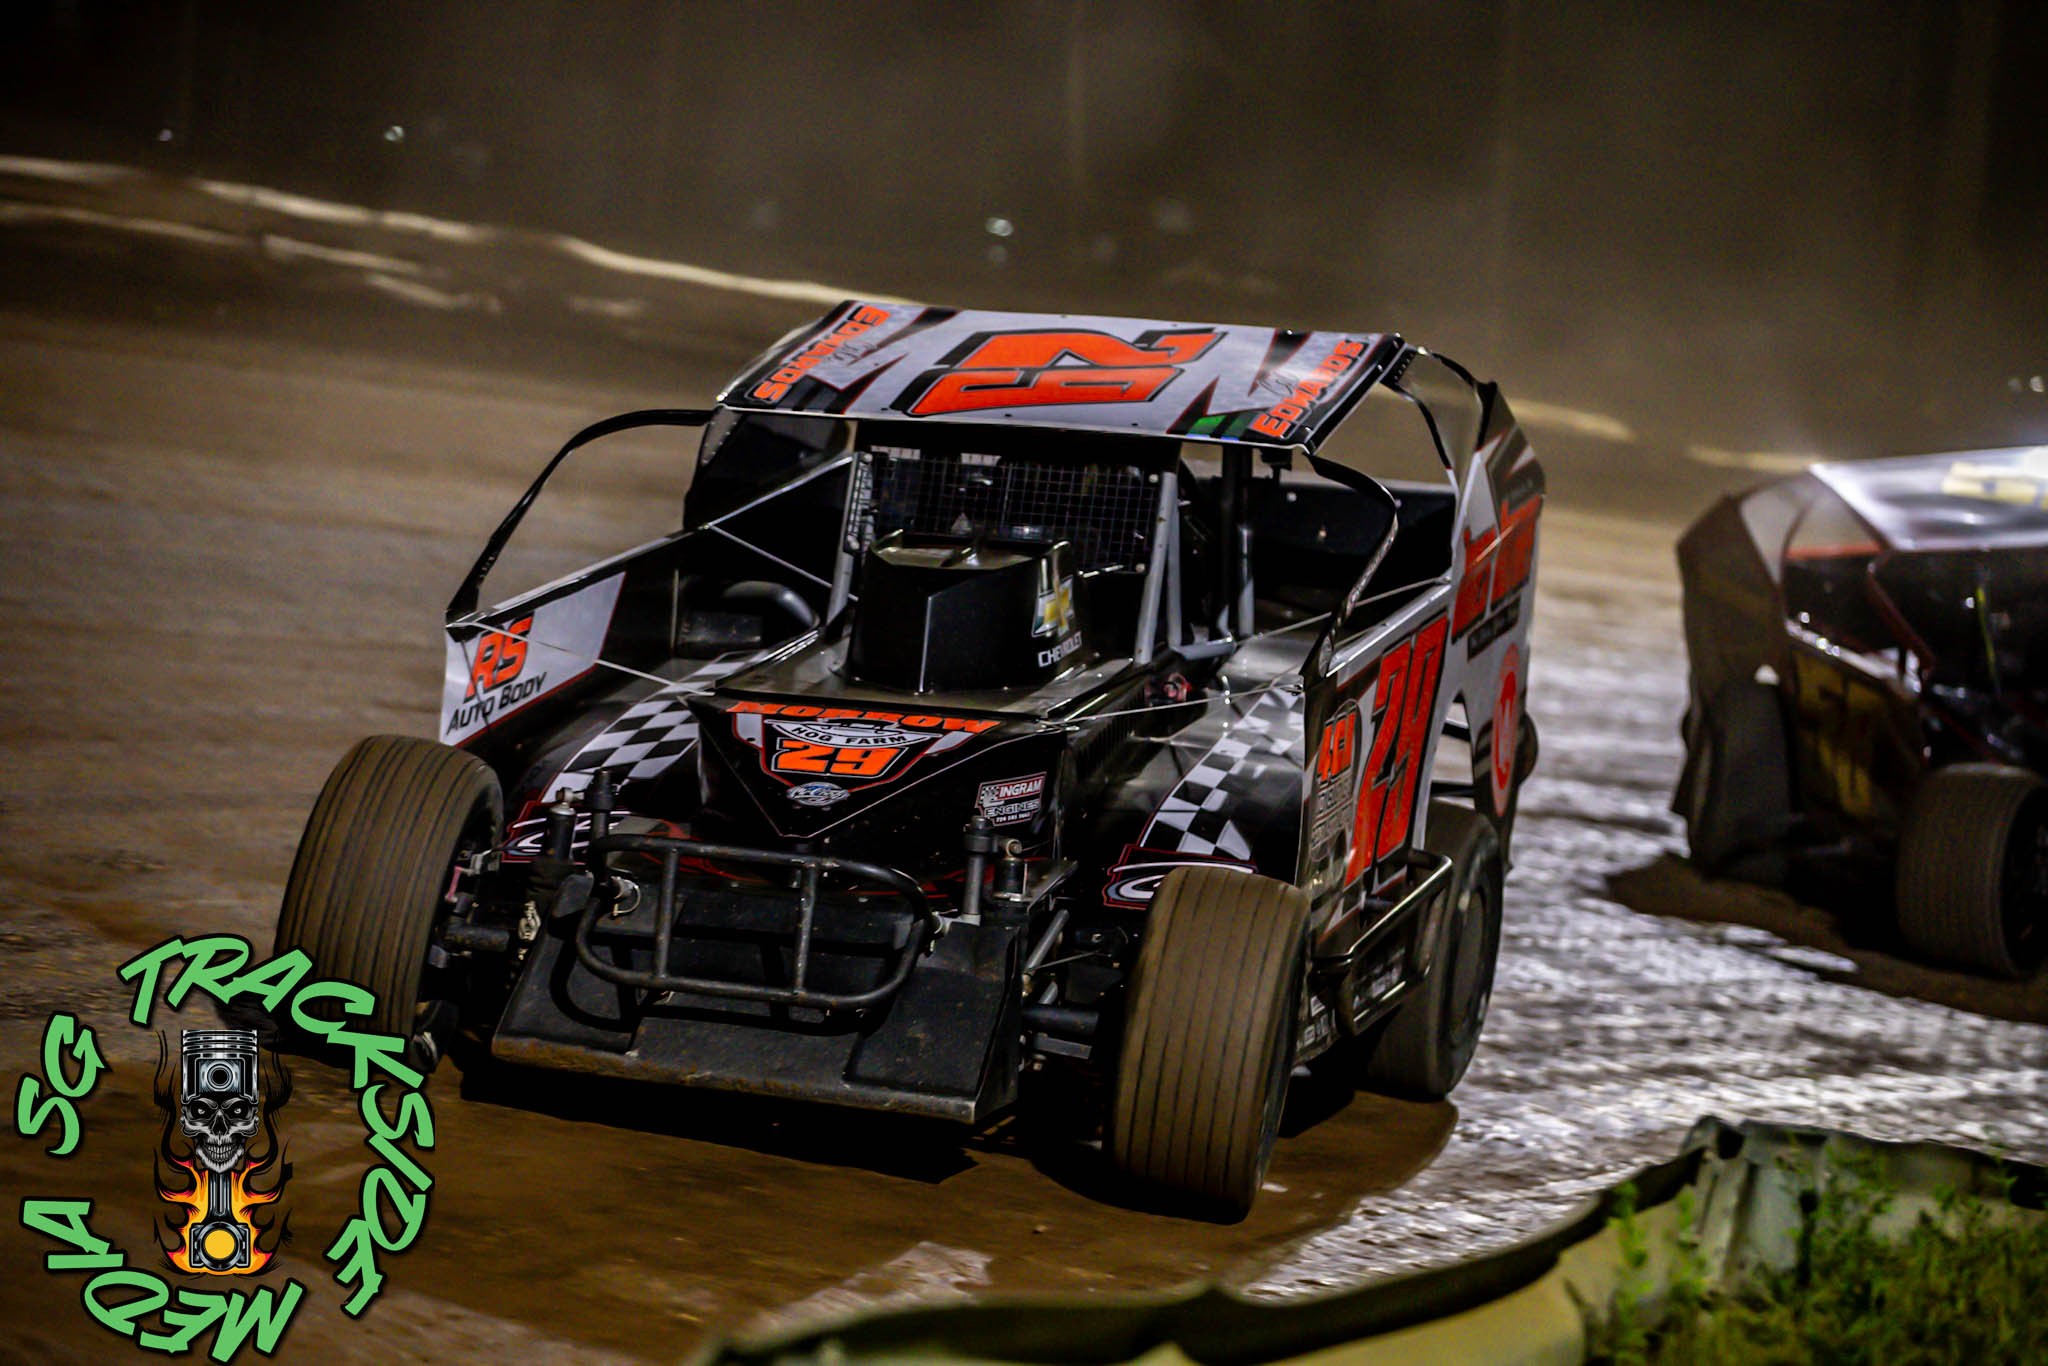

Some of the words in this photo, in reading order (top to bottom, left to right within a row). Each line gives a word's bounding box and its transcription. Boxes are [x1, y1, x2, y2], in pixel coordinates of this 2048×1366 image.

[751, 303, 891, 402] EDWARDS
[894, 330, 1226, 415] 29
[1251, 339, 1368, 438] EDWARDS
[464, 613, 534, 703] RS
[446, 695, 495, 735] AUTO
[498, 671, 548, 710] BODY
[726, 701, 1001, 733] MORROW
[774, 738, 903, 777] 29
[791, 727, 832, 743] HOG
[845, 734, 908, 746] FARM
[984, 799, 1041, 817] ENGINES
[999, 779, 1043, 798] INGRAM
